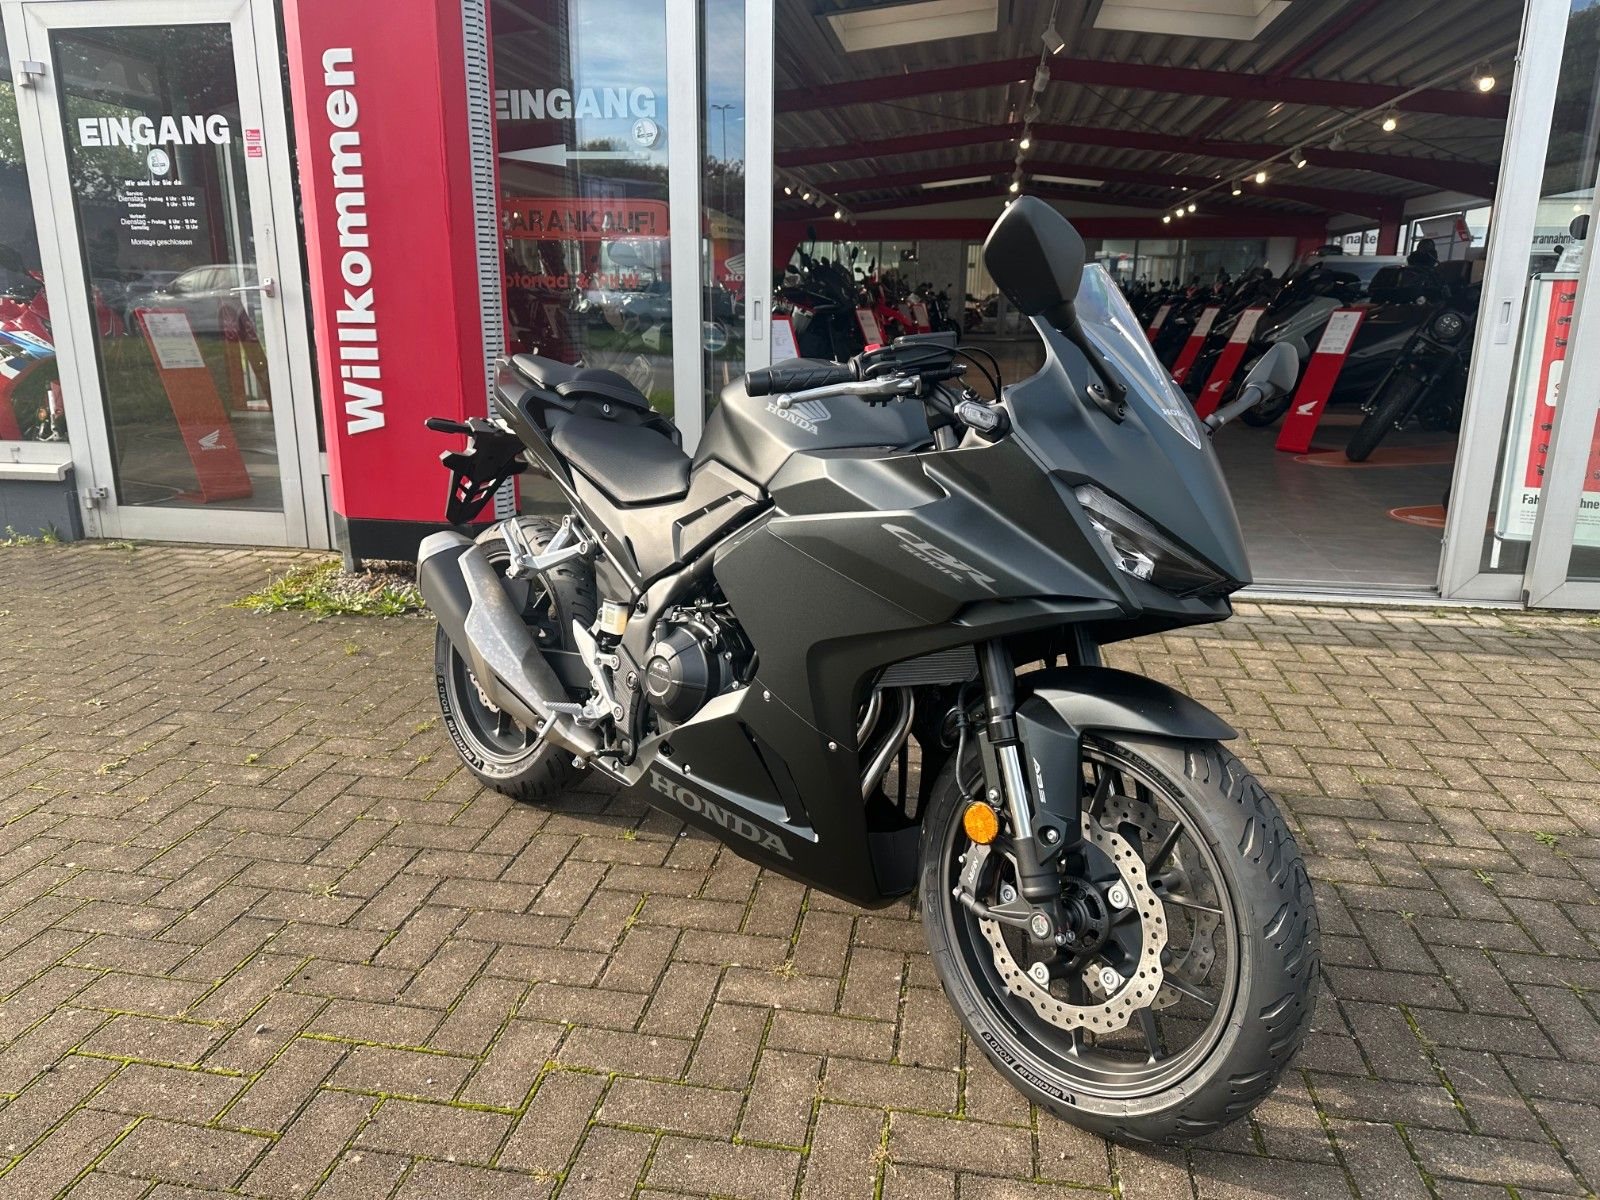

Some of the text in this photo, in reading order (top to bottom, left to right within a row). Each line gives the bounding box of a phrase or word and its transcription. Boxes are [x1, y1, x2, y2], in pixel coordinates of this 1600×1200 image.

[495, 87, 656, 119] EINGANG
[78, 114, 231, 147] EINGANG
[118, 195, 144, 203] Dienstag
[131, 238, 193, 247] Montags geschlossen
[322, 47, 385, 435] Willkommen
[506, 272, 569, 289] otorrad
[765, 402, 819, 435] HONDA
[1522, 493, 1600, 510] Fah hne
[881, 523, 999, 595] CBR
[439, 686, 451, 713] ROAD
[447, 719, 475, 761] MICHELIN
[650, 769, 794, 861] HONDA
[983, 1032, 1062, 1098] MICHELIN ROAD 6
